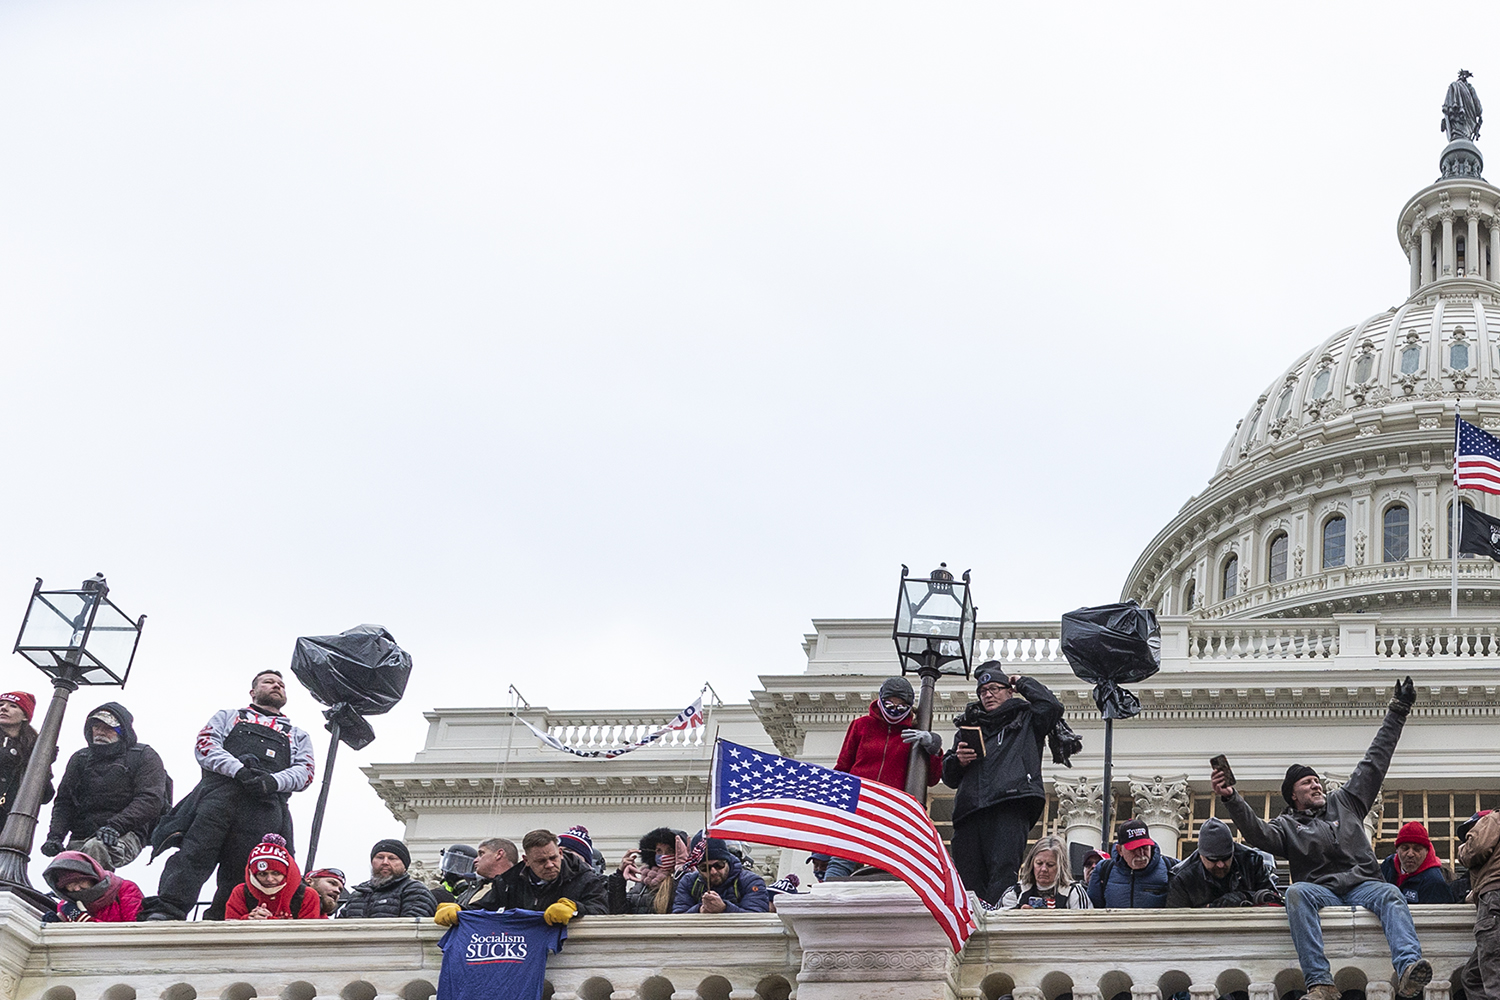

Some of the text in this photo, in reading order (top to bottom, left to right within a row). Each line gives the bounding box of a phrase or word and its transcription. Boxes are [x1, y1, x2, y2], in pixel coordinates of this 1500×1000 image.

[251, 845, 288, 859] RUM
[470, 932, 525, 944] Socialism
[465, 943, 528, 958] SUCKS
